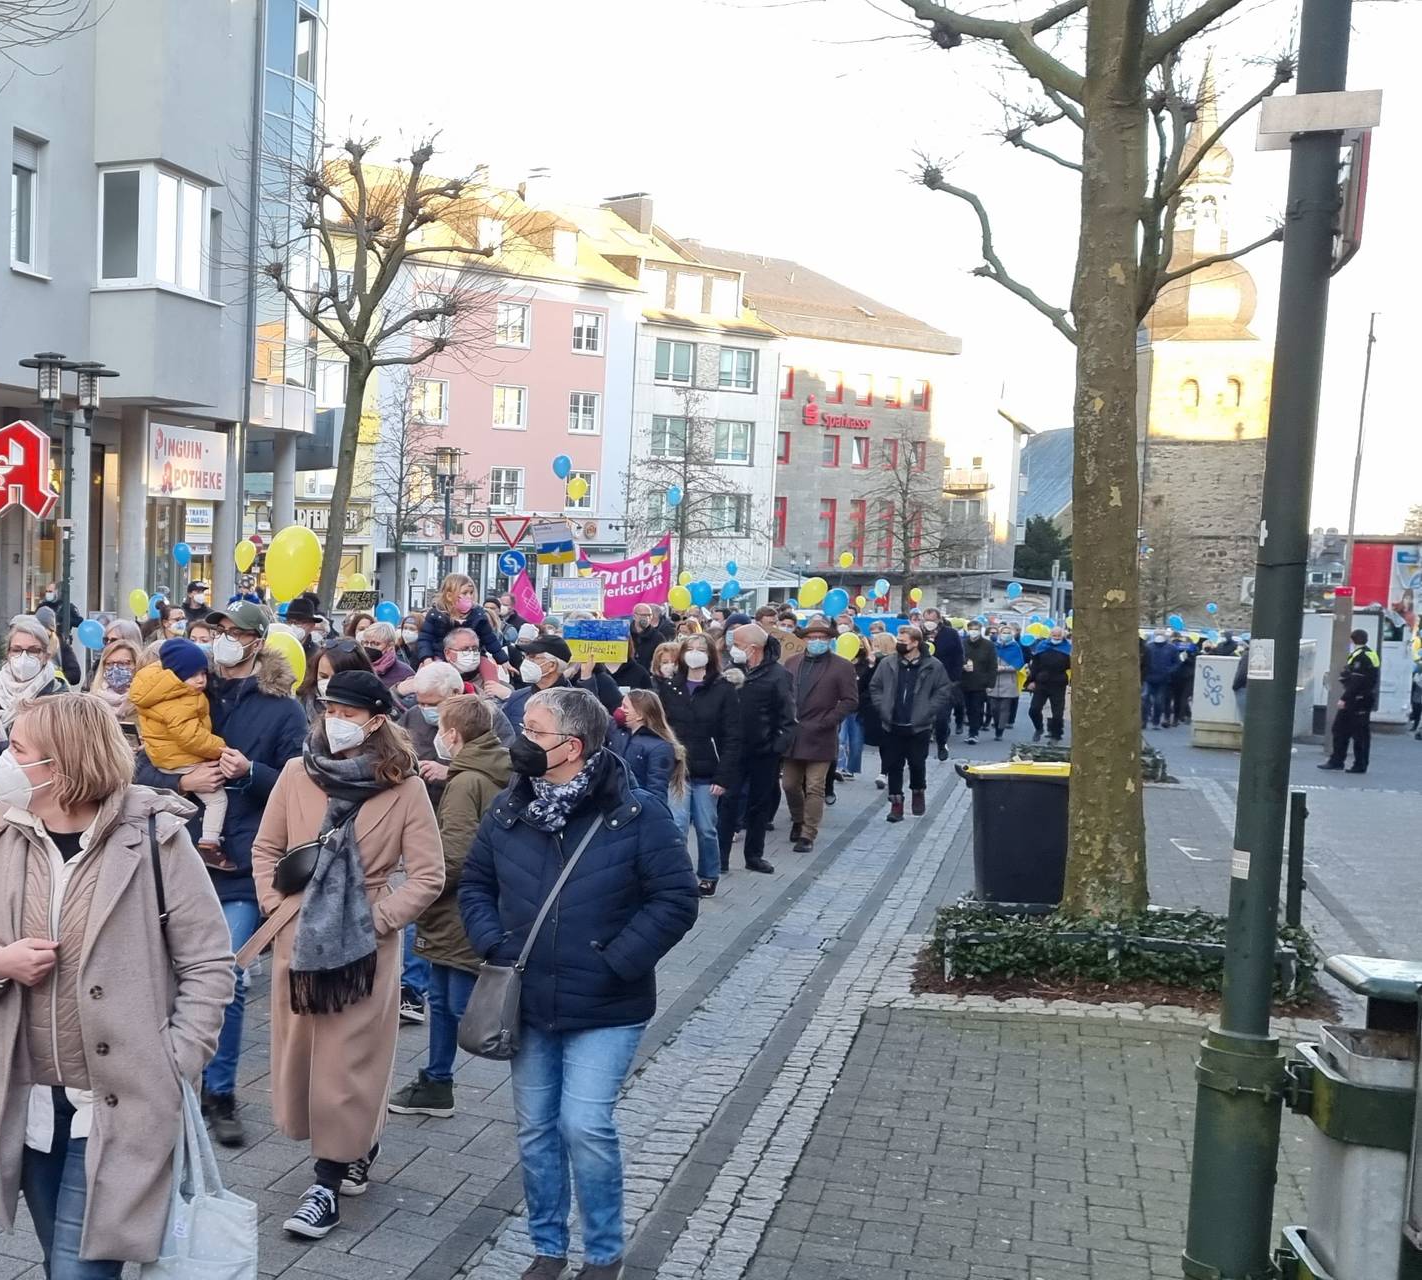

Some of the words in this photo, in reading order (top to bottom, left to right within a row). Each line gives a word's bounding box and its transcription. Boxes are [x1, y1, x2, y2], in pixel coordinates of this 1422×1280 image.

[154, 427, 202, 460] PINGUIN
[162, 461, 222, 495] APOTHEKE
[471, 524, 482, 534] 20
